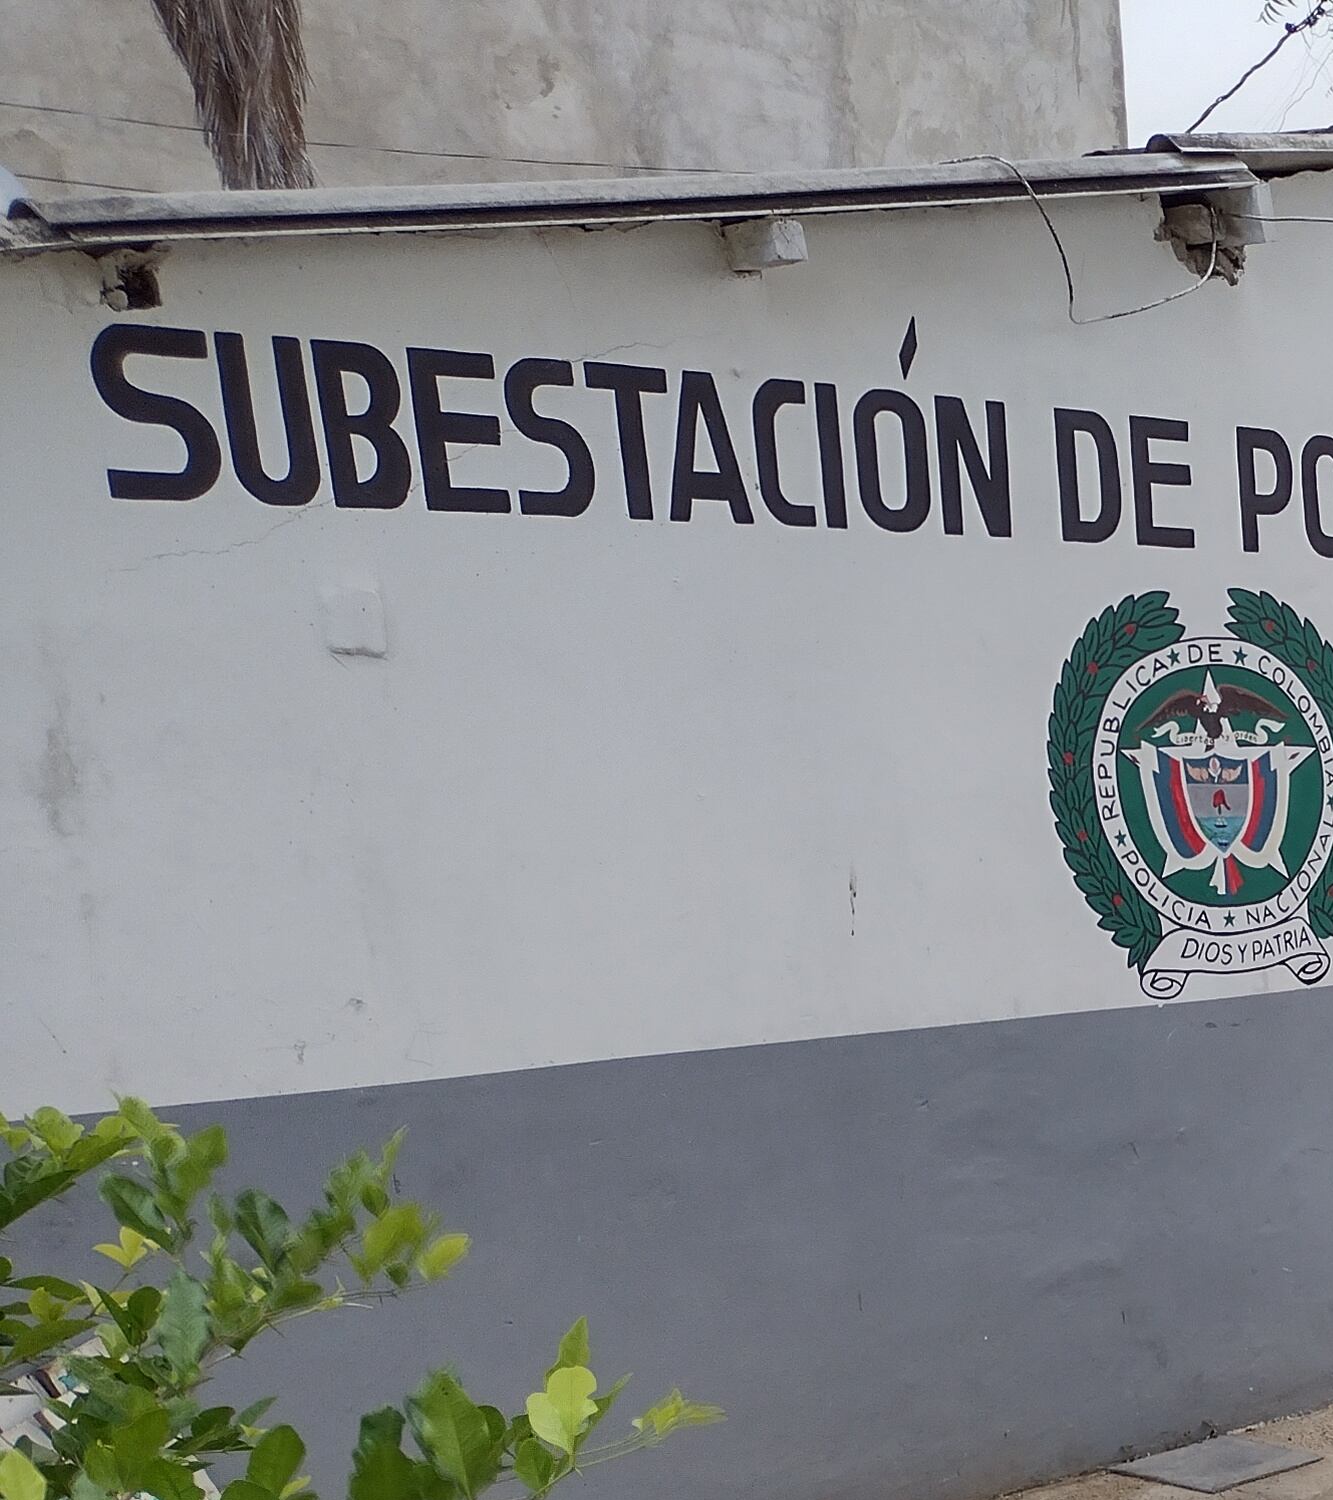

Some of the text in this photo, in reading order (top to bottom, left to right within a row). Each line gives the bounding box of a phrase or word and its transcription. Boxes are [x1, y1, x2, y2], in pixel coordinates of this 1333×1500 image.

[90, 316, 1012, 538] SUBESTACIÓN
[1054, 408, 1195, 549] DE
[1097, 655, 1171, 821] REPUBLICA
[1188, 644, 1224, 663] DE
[1122, 850, 1211, 930] POLICIA
[1180, 931, 1312, 965] DIOS Y PATRIA
